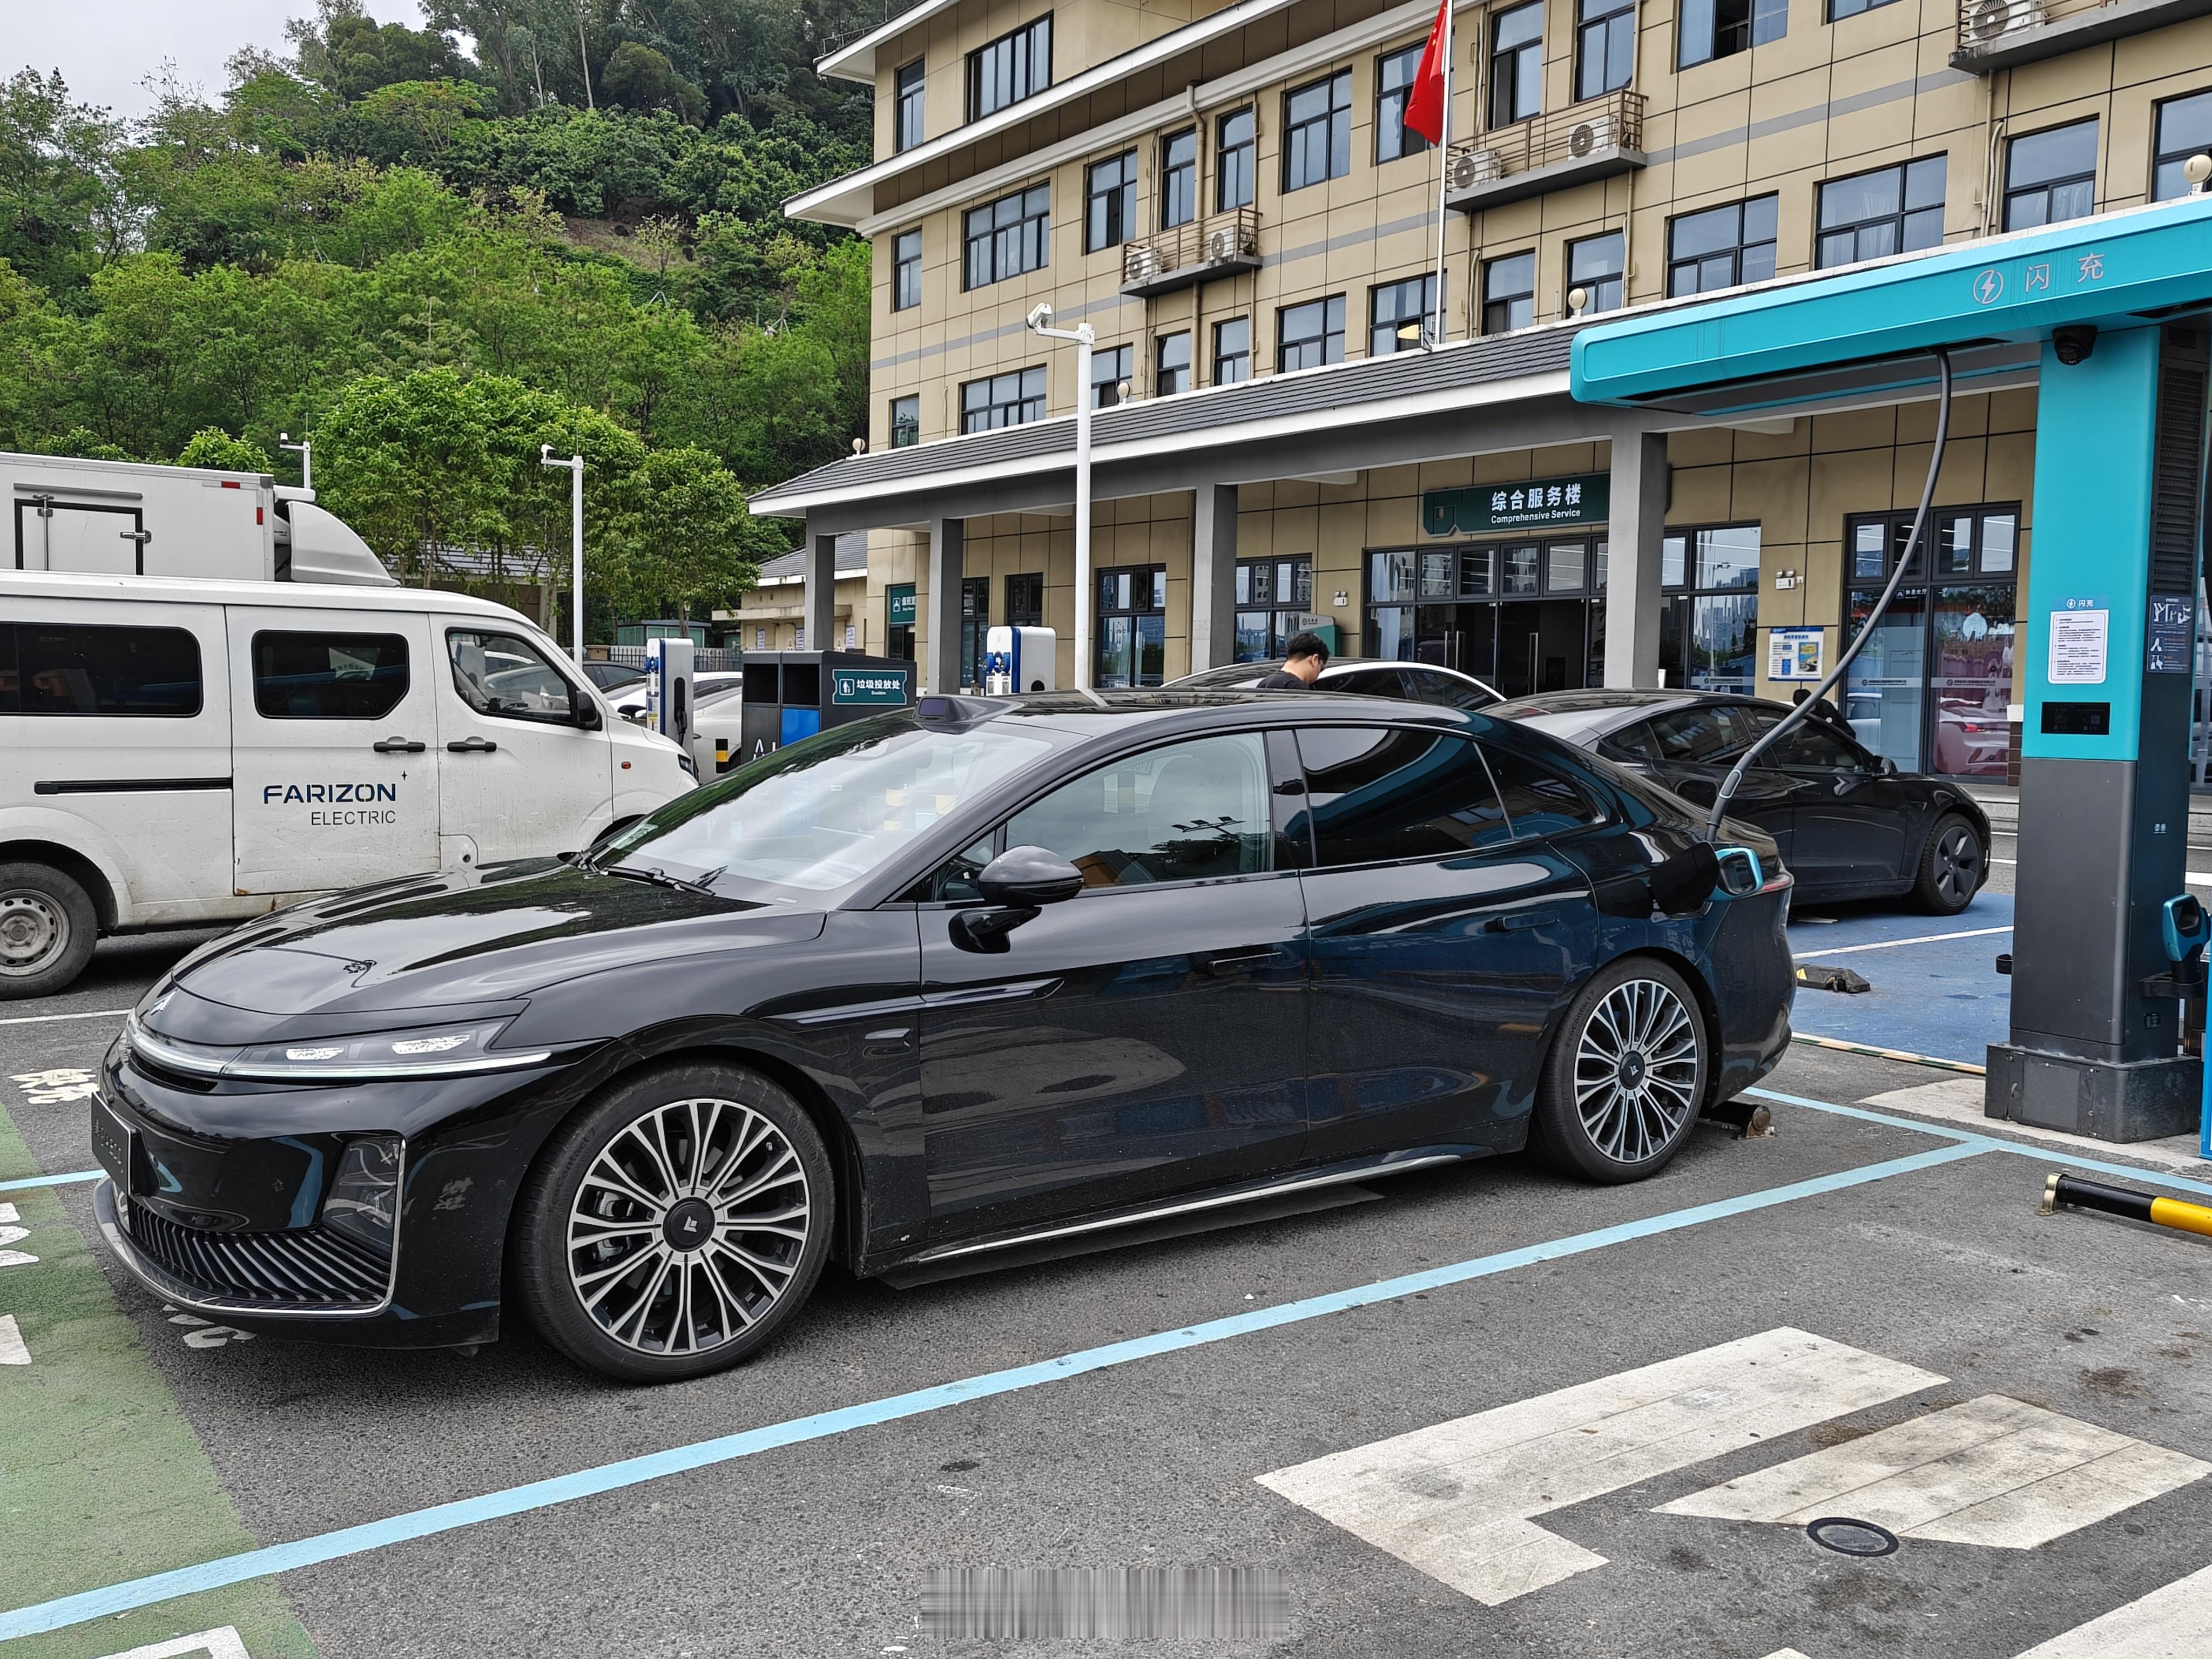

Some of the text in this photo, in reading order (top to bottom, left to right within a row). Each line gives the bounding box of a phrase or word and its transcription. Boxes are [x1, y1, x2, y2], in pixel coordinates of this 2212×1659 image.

[2025, 252, 2105, 293] 闪充
[1491, 483, 1581, 511] 综合服务楼
[1491, 509, 1581, 524] Comprehensive Service
[2079, 599, 2094, 608] 闪充
[857, 679, 901, 690] 垃圾投放处
[264, 783, 396, 804] FARIZON
[311, 811, 396, 825] ELECTRIC
[1566, 996, 1591, 1048] EcoContact
[547, 1136, 590, 1212] EcoContact
